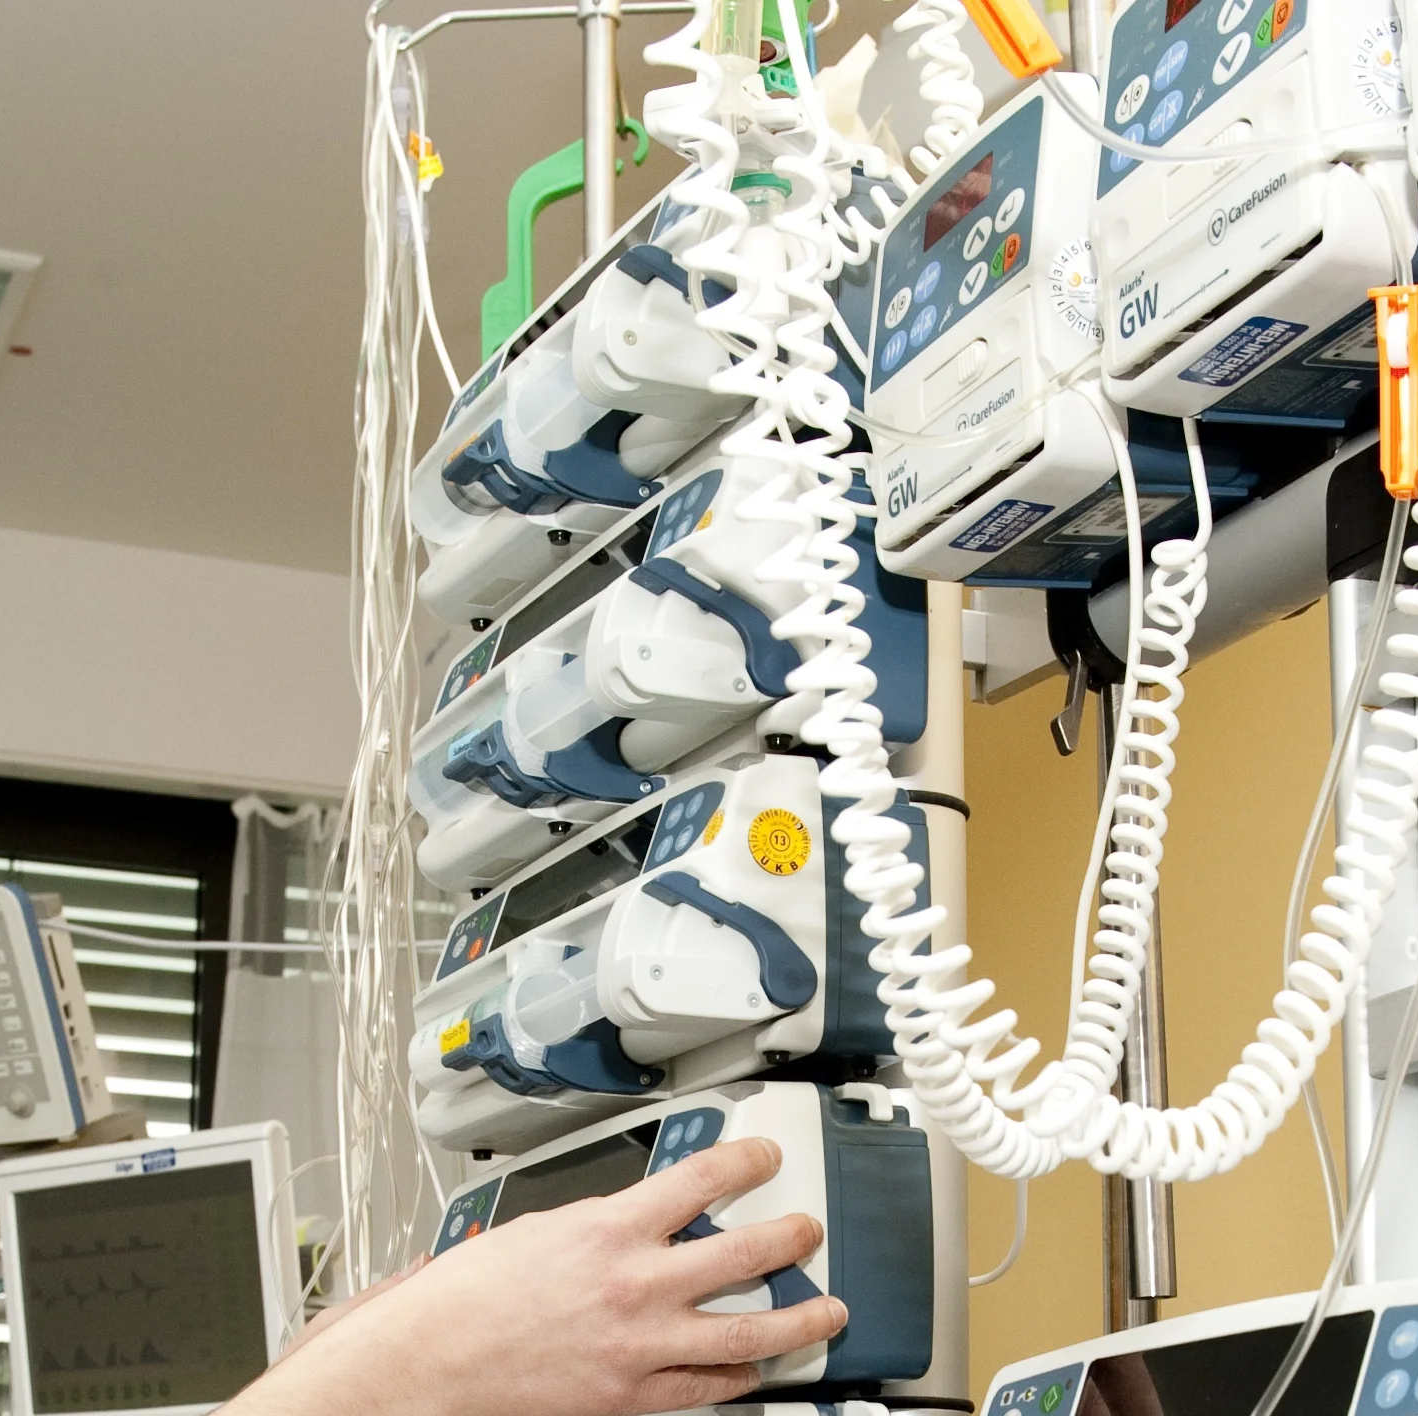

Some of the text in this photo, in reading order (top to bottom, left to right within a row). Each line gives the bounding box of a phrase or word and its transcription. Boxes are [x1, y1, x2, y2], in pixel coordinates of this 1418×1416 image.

[1228, 172, 1287, 224] CareFusion
[1119, 283, 1159, 339] GW
[1203, 323, 1290, 385] MED-INTENSIV
[970, 388, 1016, 428] CareFusion
[887, 472, 918, 519] GW
[963, 502, 1030, 549] MED-INTENSIV
[774, 834, 786, 846] 13
